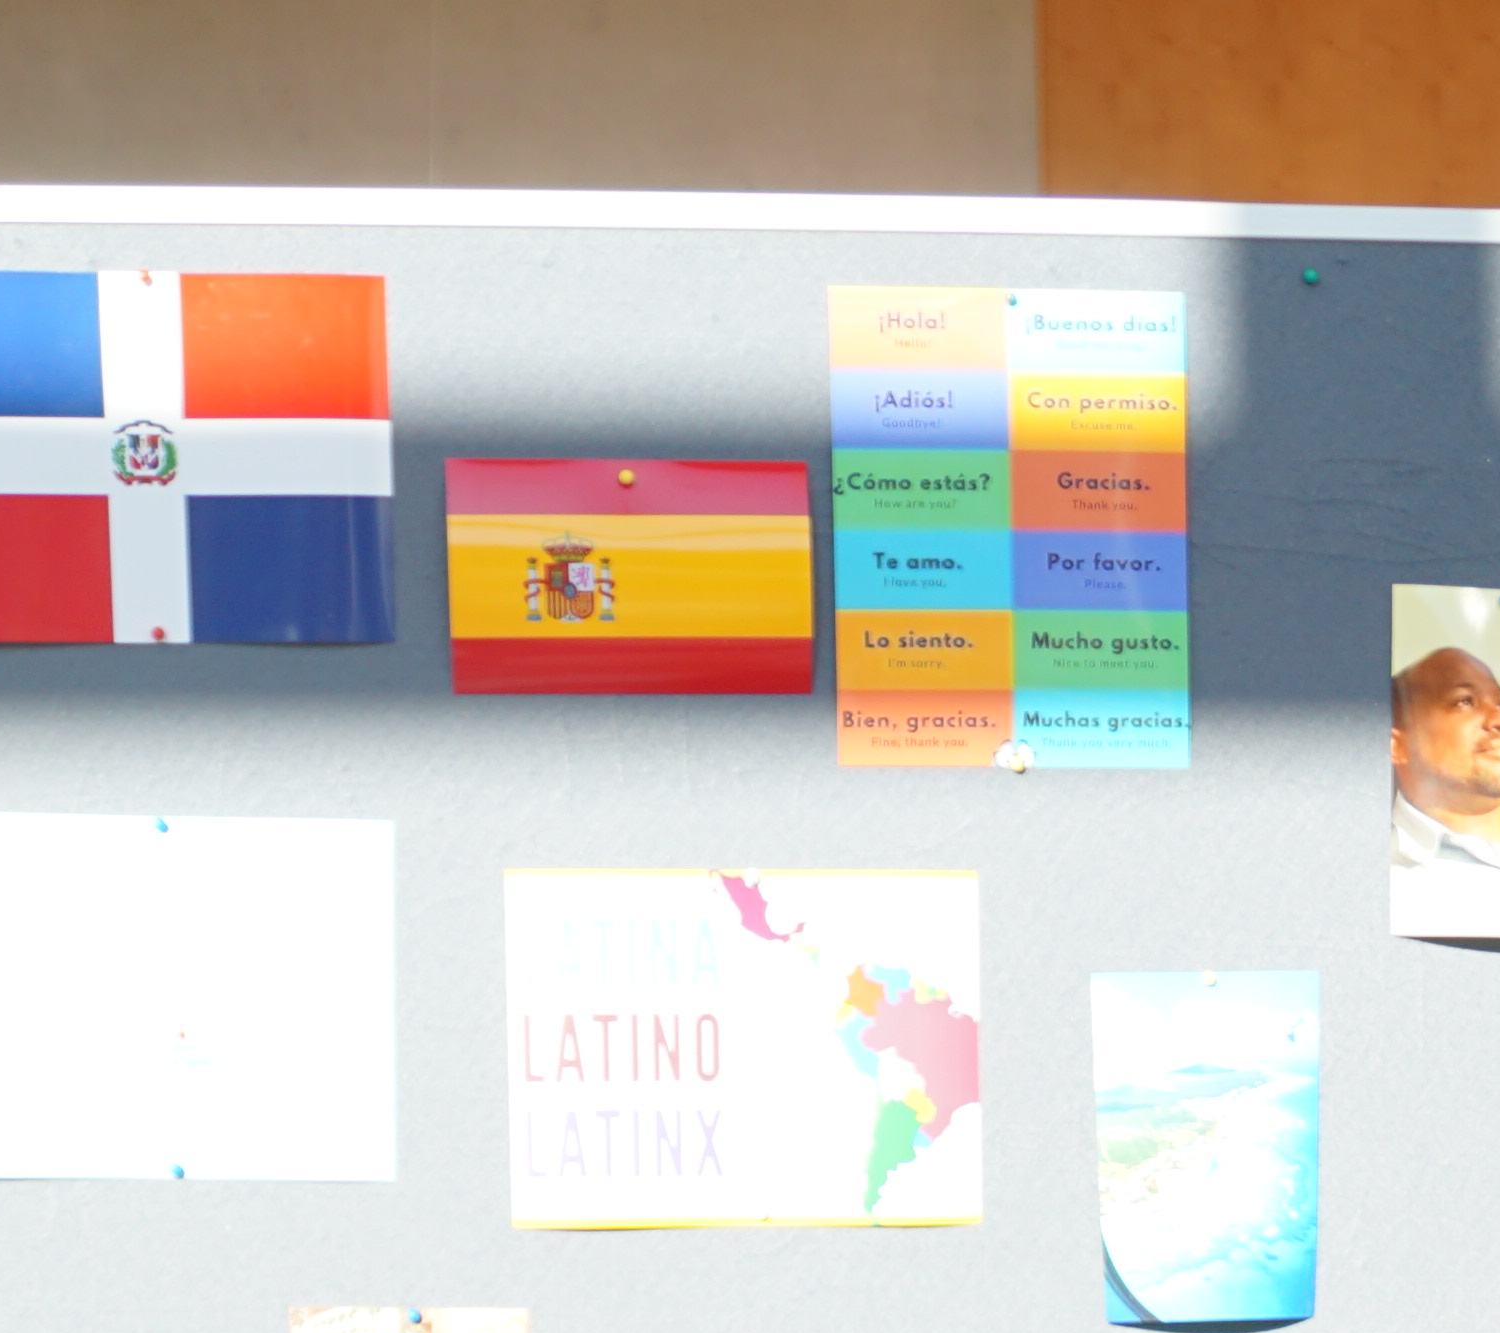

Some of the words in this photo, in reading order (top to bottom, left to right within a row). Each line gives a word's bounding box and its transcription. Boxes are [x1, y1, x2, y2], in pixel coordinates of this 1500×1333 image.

[878, 313, 947, 333] ¡Hola!
[1025, 314, 1114, 336] ¡Buenos
[875, 390, 954, 413] ¡Adiós!
[1027, 392, 1070, 409] Con
[1079, 392, 1178, 415] permiso.
[833, 471, 912, 496] ¿Cómo
[920, 472, 991, 491] estás?
[1057, 472, 1152, 492] Gracias.
[874, 499, 900, 510] How
[903, 501, 926, 510] are
[929, 499, 957, 512] you?
[1072, 499, 1107, 511] Thank
[1110, 501, 1138, 513] you.
[873, 553, 900, 570] Te
[905, 555, 964, 570] amo.
[1046, 553, 1084, 571] Por
[1093, 552, 1162, 573] favor.
[1084, 578, 1126, 590] Please.
[864, 631, 890, 649] Lo
[898, 630, 974, 650] siento.
[1031, 632, 1103, 651] Mucho
[1111, 633, 1181, 655] gusto.
[842, 711, 897, 732] Bien,
[906, 711, 997, 734] gracias.
[1023, 710, 1100, 730] Muchas
[1108, 711, 1192, 733] gracias.
[871, 736, 901, 749] Fine,
[904, 736, 939, 748] thank
[524, 1013, 721, 1082] LATINO
[526, 1109, 723, 1178] LATINX
